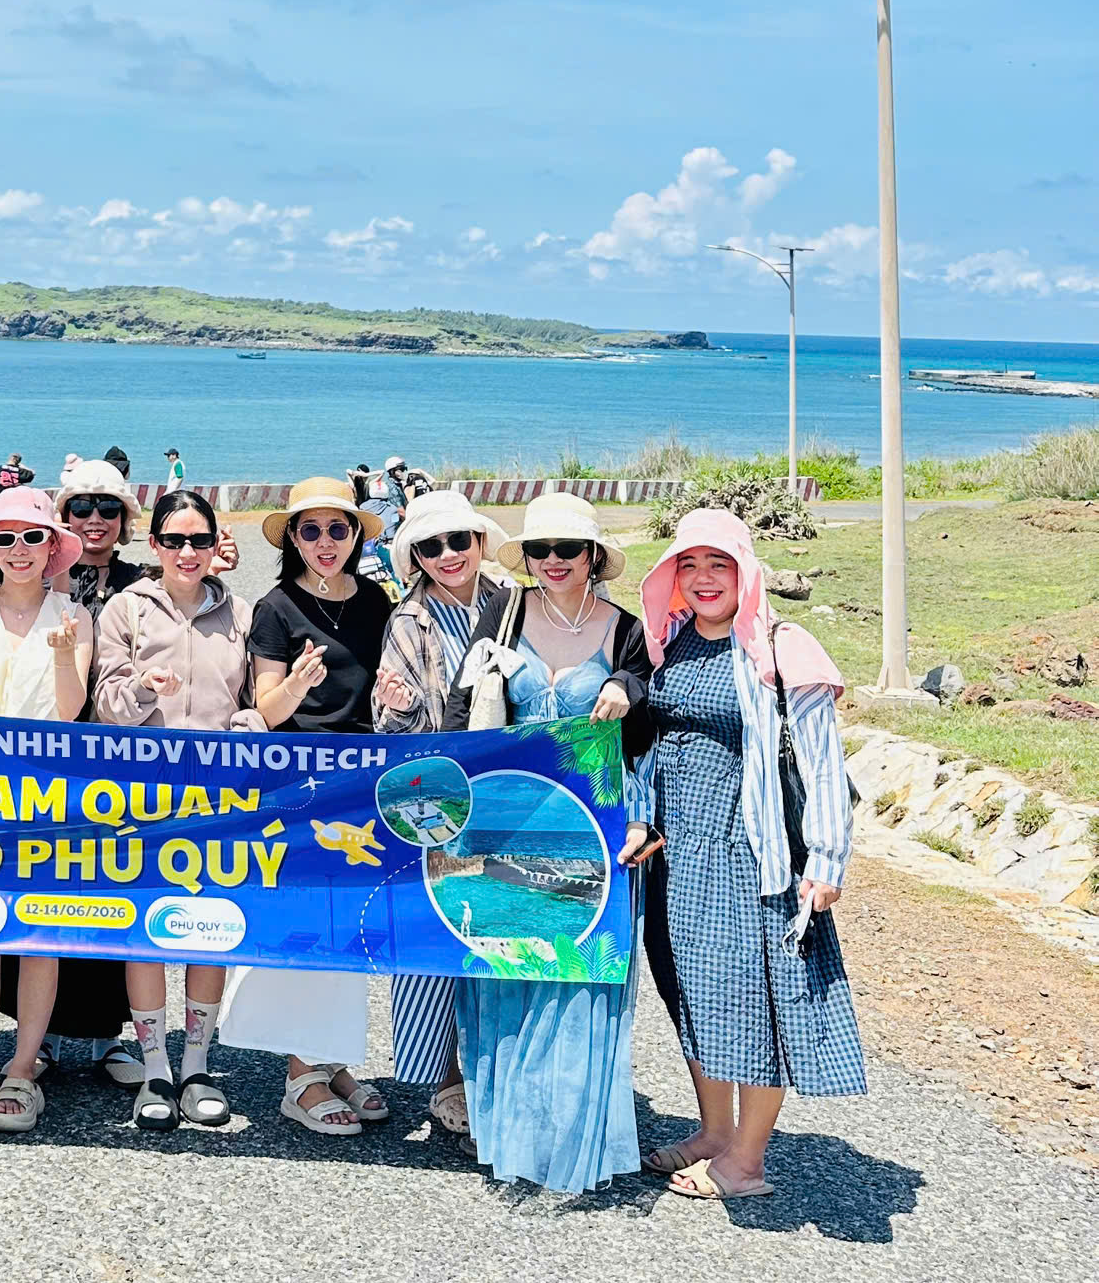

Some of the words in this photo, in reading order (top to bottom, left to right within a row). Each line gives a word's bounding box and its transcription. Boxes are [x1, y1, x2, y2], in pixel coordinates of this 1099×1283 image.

[81, 734, 185, 764] TMDV
[194, 741, 387, 772] VINOTECH
[81, 779, 261, 827] QUAN
[17, 825, 143, 884] PHÚ
[158, 818, 289, 894] QUÝ
[25, 903, 126, 918] 12-14/06/2026
[202, 935, 234, 943] TRAVEL
[222, 922, 244, 932] SEA
